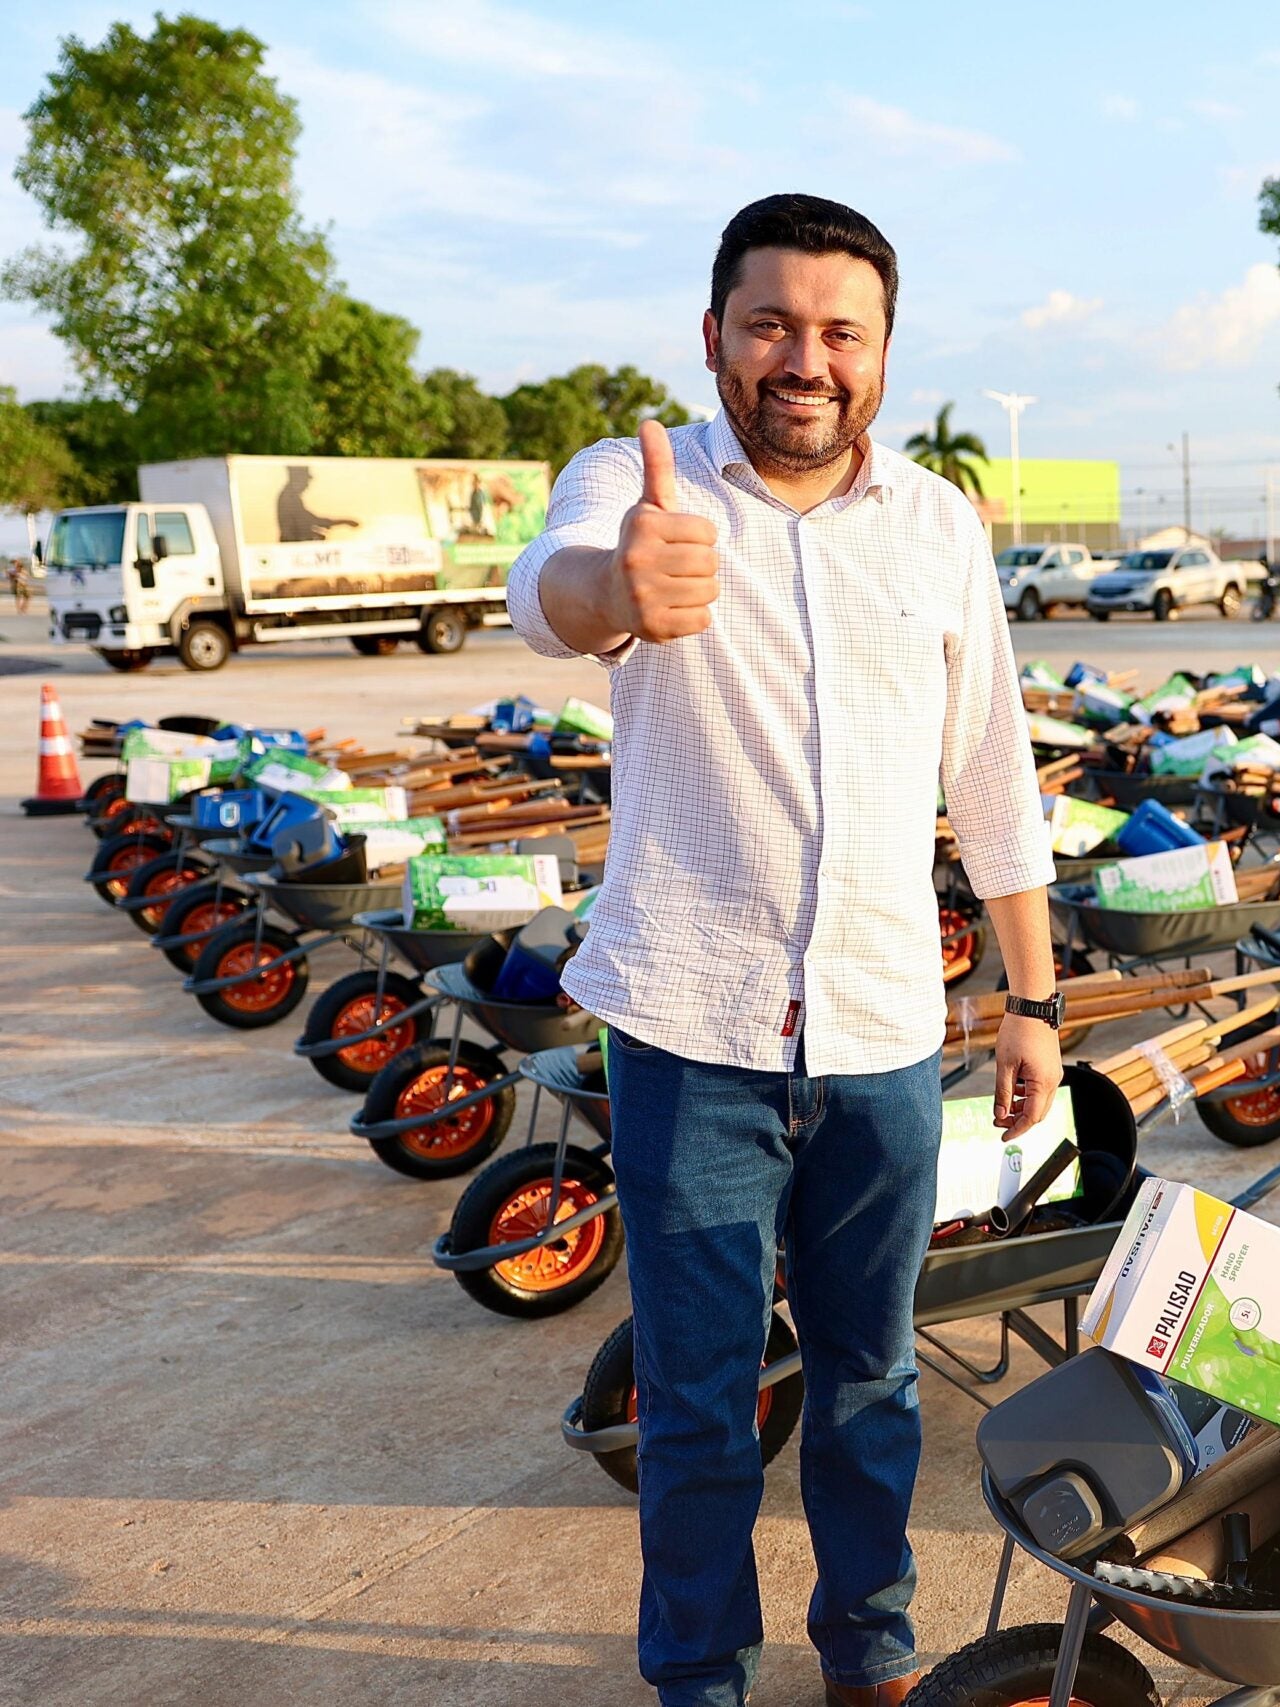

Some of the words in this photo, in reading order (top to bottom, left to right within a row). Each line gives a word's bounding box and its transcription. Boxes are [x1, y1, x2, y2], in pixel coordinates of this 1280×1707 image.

[1221, 1252, 1236, 1279] HAND
[1228, 1243, 1250, 1282] SPRAYER
[1155, 1271, 1197, 1338] PALISAD
[1180, 1302, 1215, 1370] PULVERIZADOR
